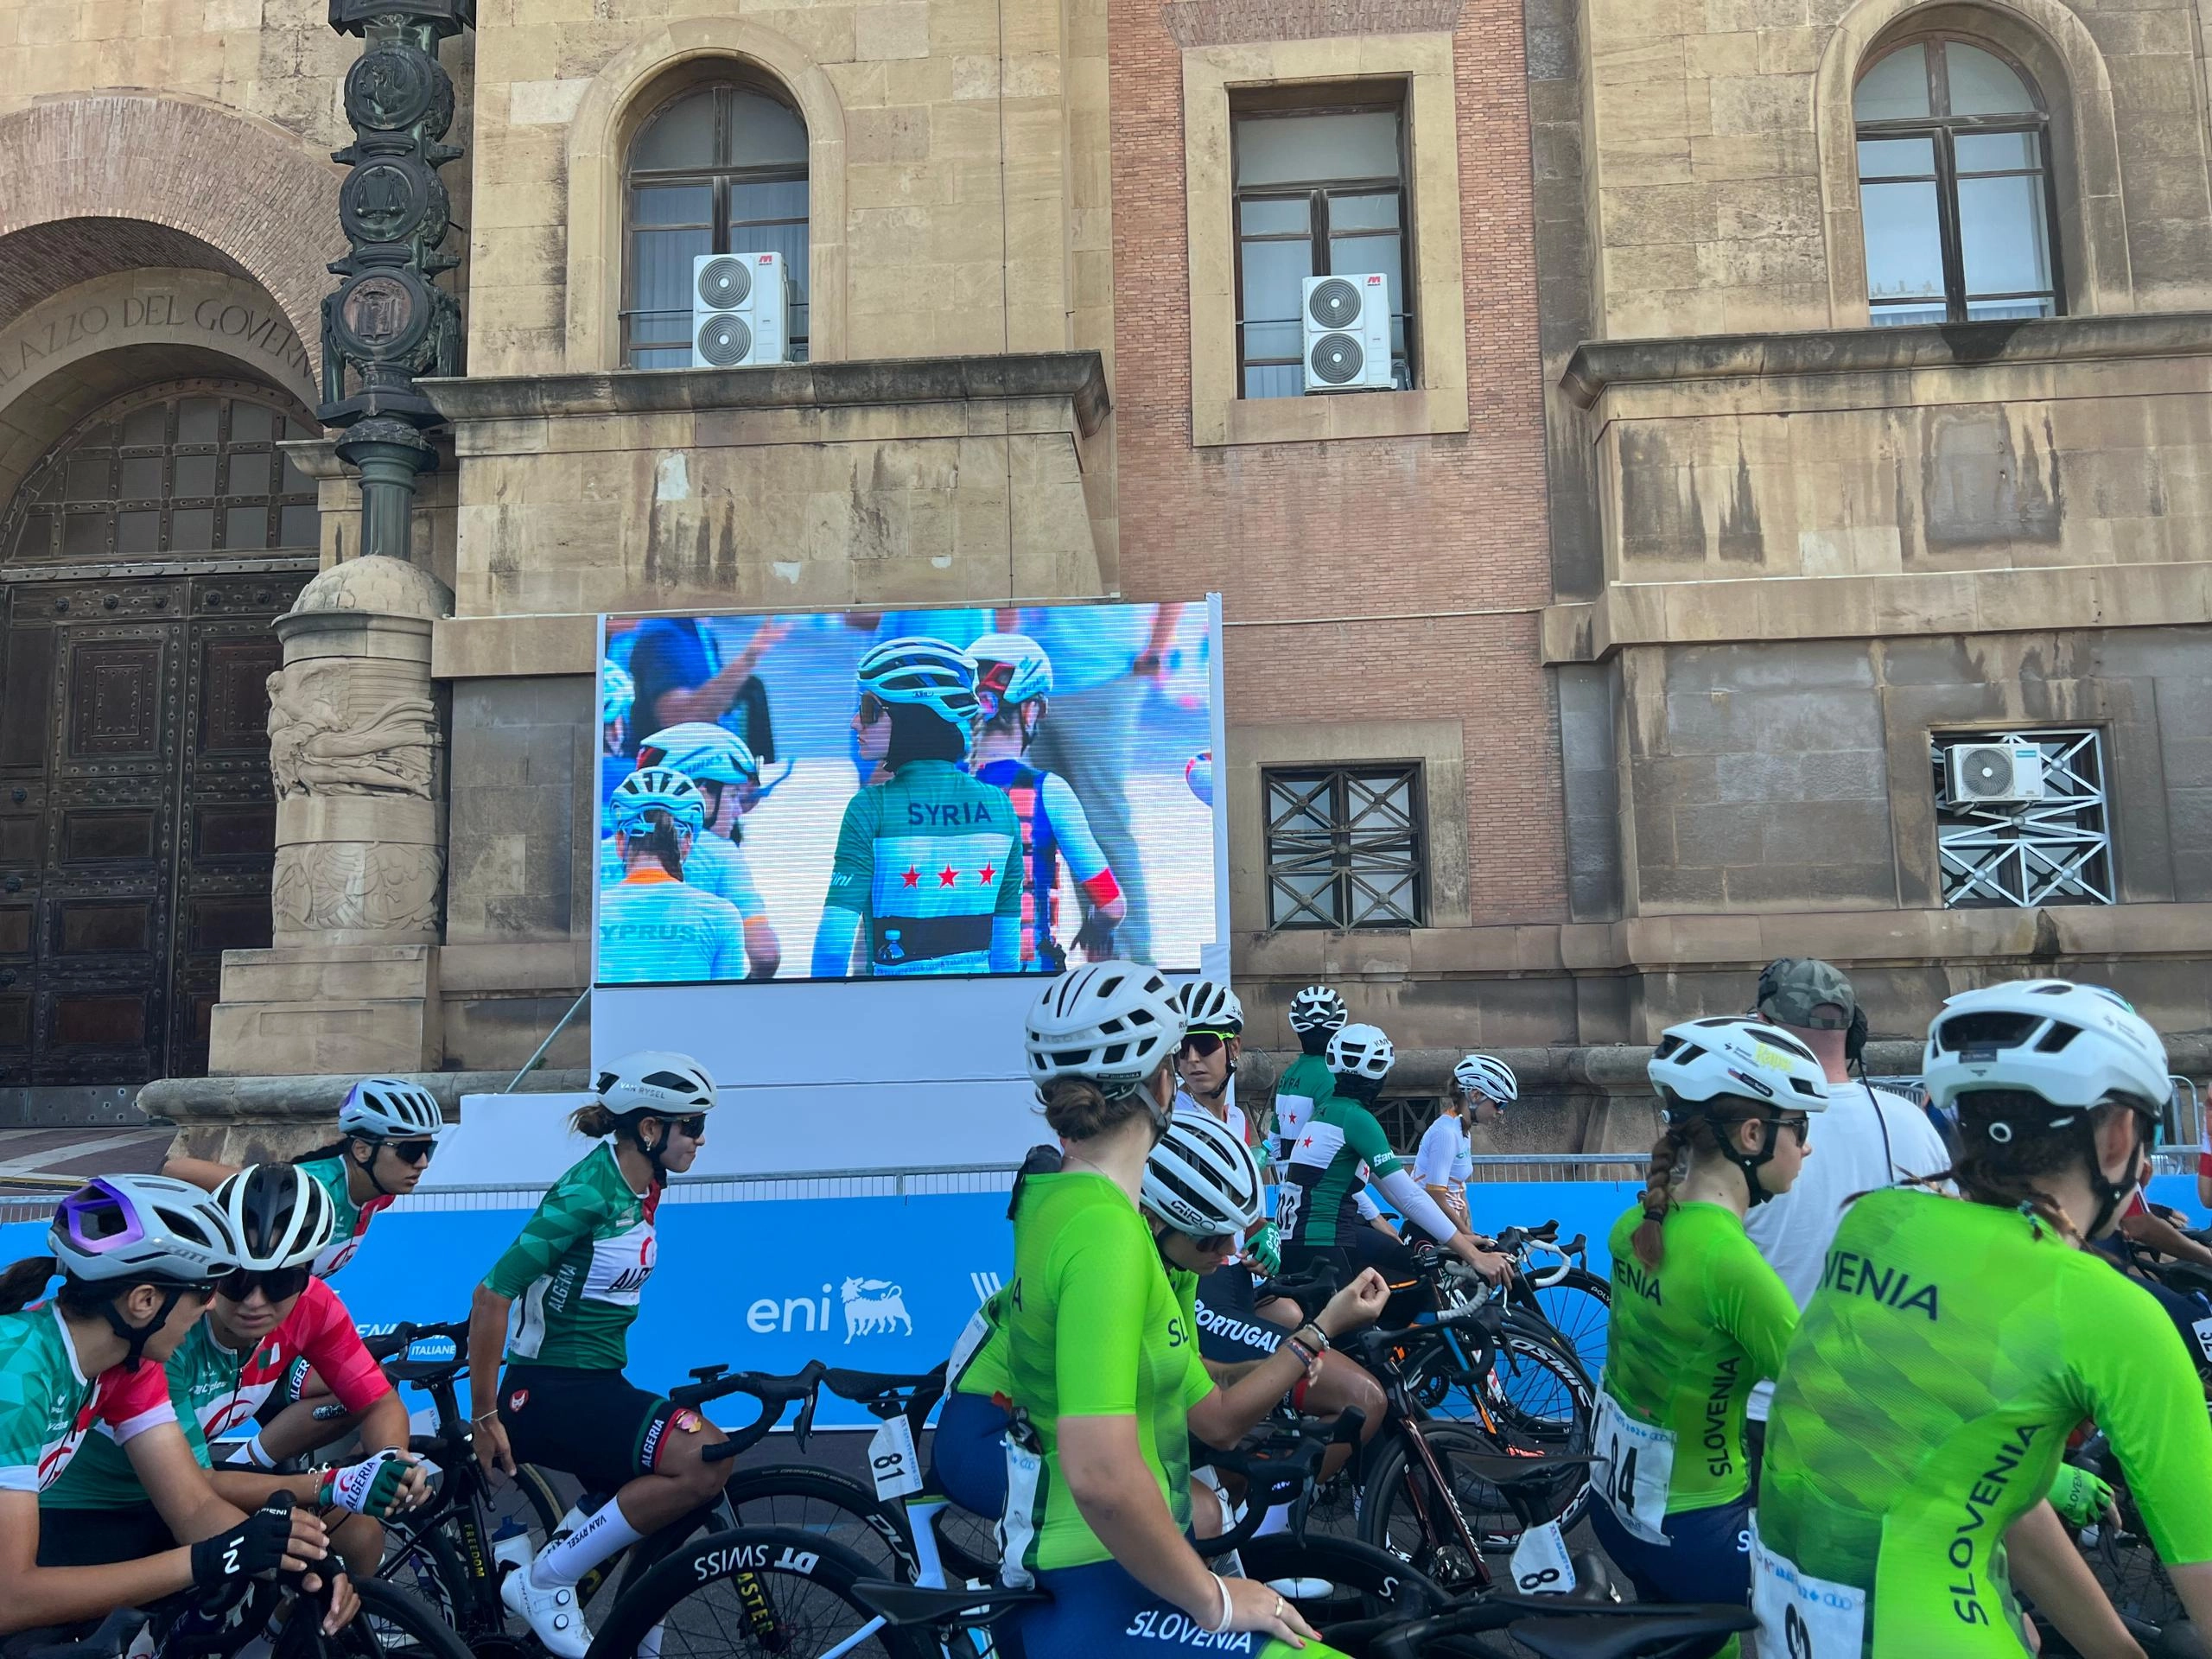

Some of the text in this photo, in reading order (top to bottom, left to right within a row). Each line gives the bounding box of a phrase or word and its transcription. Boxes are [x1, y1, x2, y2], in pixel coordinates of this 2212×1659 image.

[0, 296, 311, 383] LAZZO DEL GOVERN
[908, 801, 992, 826] SYRIA
[600, 925, 697, 942] YPRUS
[620, 1082, 665, 1099] VAN RYSEL
[1170, 1200, 1216, 1231] GIRO
[1591, 1286, 1611, 1306] POLY
[1821, 1250, 1939, 1320] VENIA
[747, 1282, 832, 1333] eni
[1195, 1299, 1281, 1353] PORTUGAL
[411, 1344, 456, 1355] ITALIANE
[290, 1358, 311, 1401] ALGER
[1704, 1356, 1740, 1477] SLOVENIA
[641, 1419, 664, 1467] ALGERIA
[346, 1461, 376, 1510] ALGERIA
[874, 1452, 906, 1482] 81
[1606, 1433, 1638, 1516] 84
[567, 1528, 591, 1549] RYSEL
[588, 1514, 607, 1533] VAN
[1948, 1424, 2046, 1626] SLOVENIA
[464, 1523, 485, 1577] FREEDOM
[694, 1544, 820, 1580] DT SWISS
[1520, 1567, 1560, 1594] 8
[736, 1572, 774, 1635] ASTER
[1126, 1611, 1251, 1654] SLOVENIA
